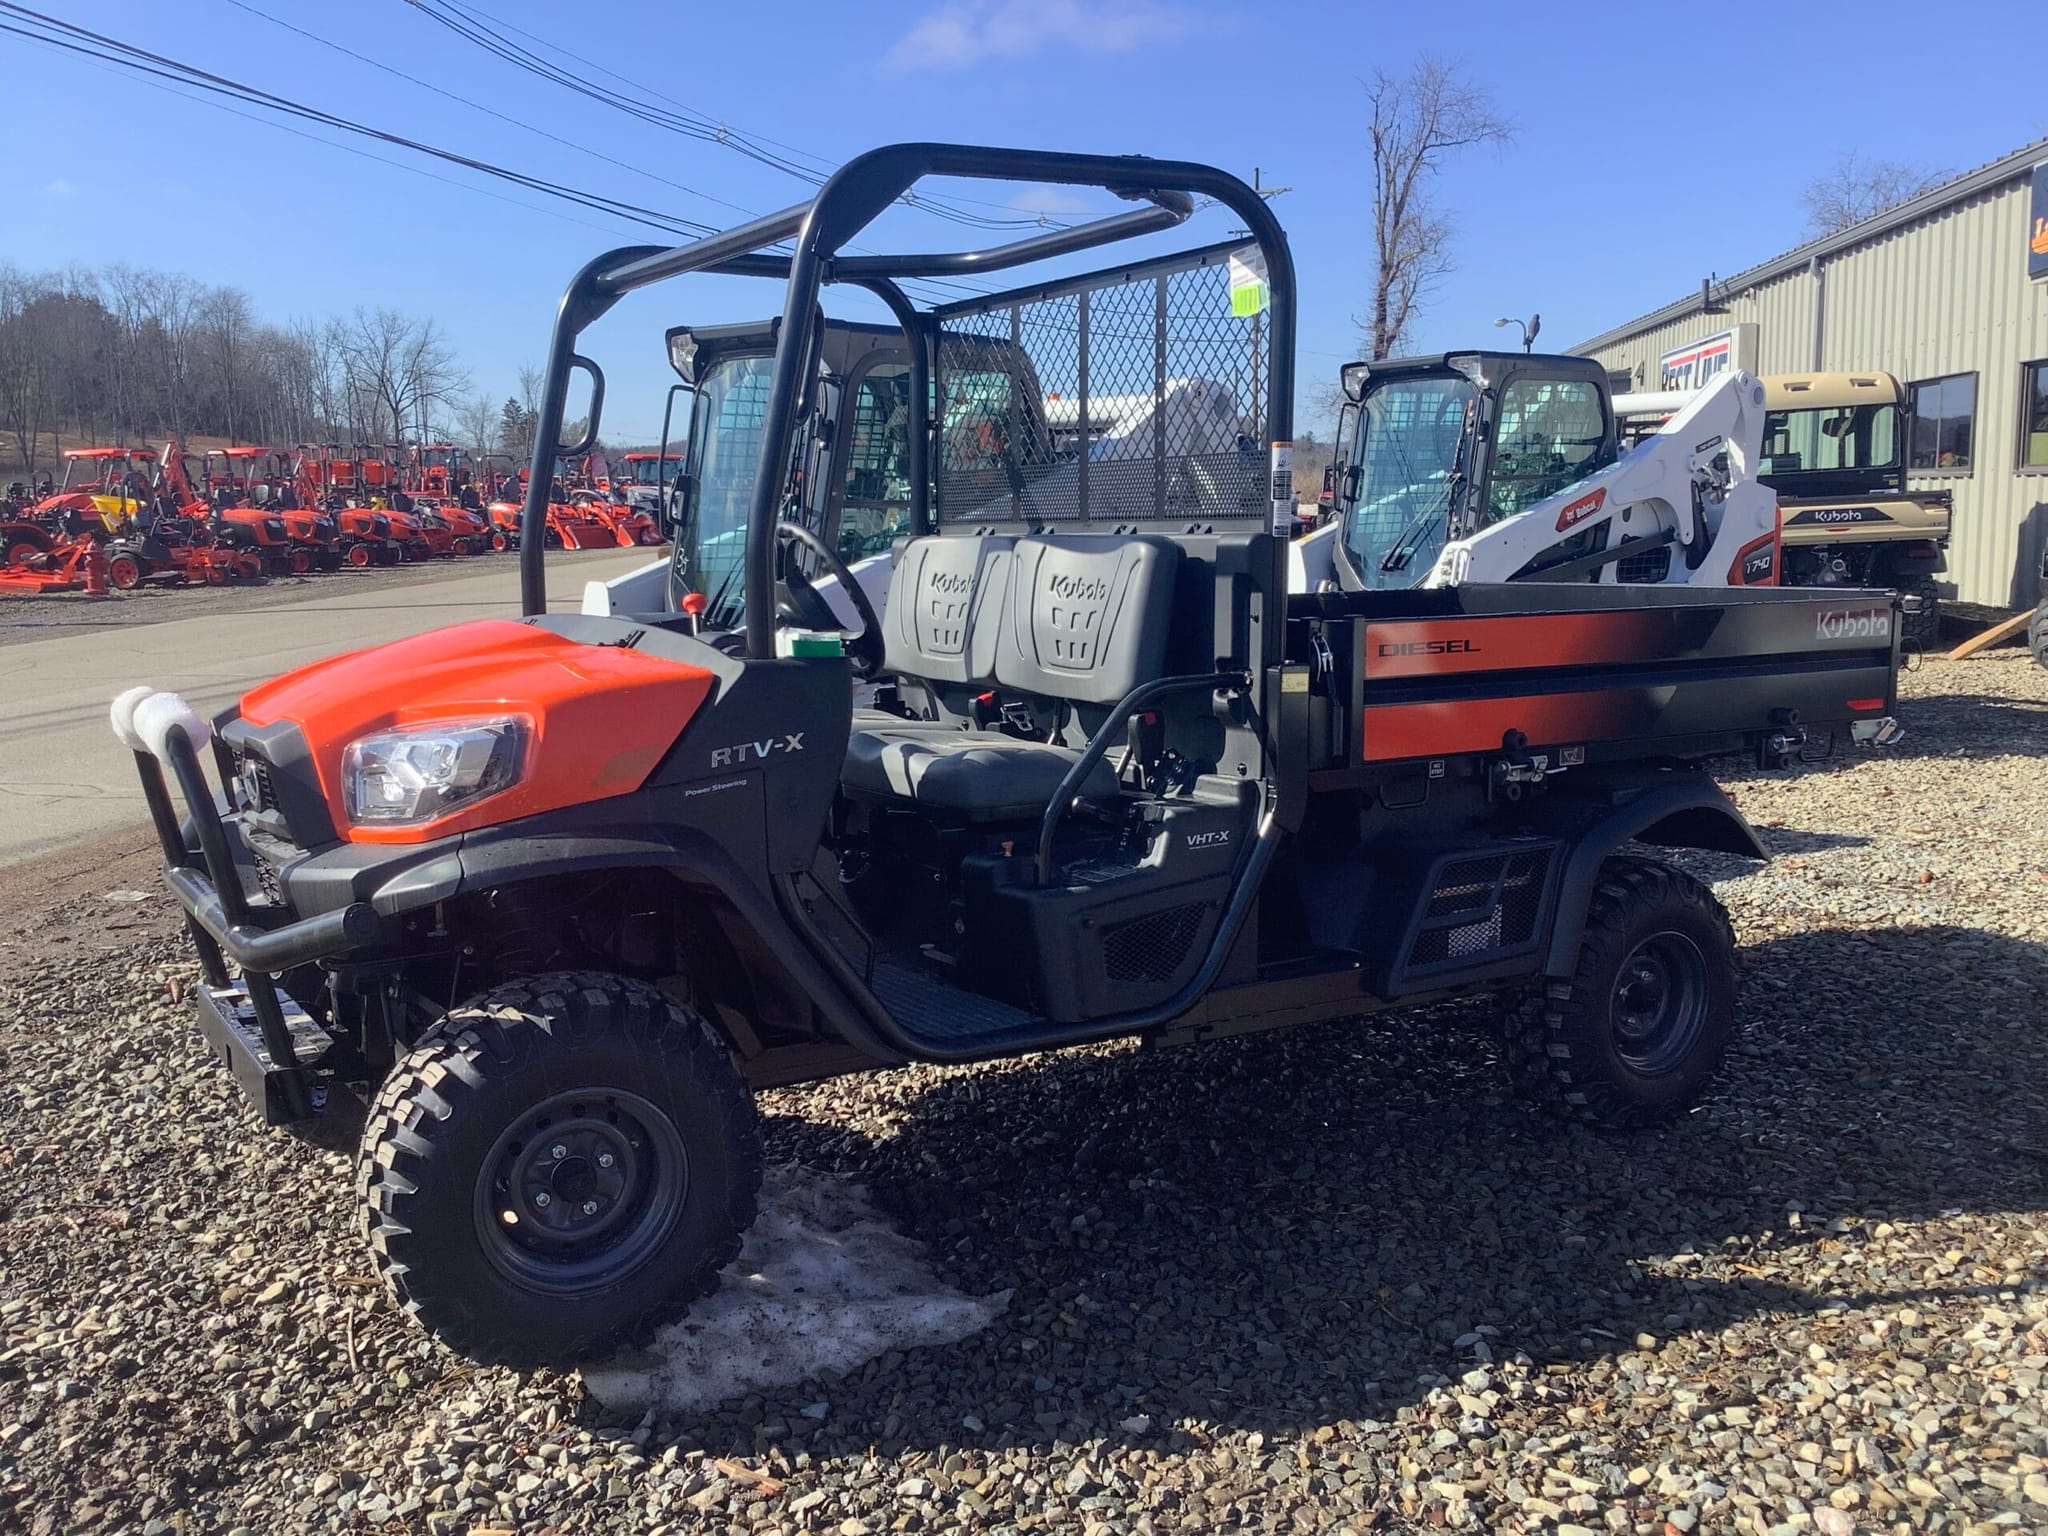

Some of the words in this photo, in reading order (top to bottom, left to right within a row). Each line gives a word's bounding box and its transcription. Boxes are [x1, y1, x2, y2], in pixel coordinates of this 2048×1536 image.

[1815, 509, 1862, 522] Kubota
[1816, 608, 1889, 639] Kubota
[1378, 639, 1482, 657] DIESEL
[711, 732, 805, 769] RTV-X
[685, 786, 711, 797] Power
[711, 779, 748, 792] Steering
[1187, 830, 1230, 846] VHT-X
